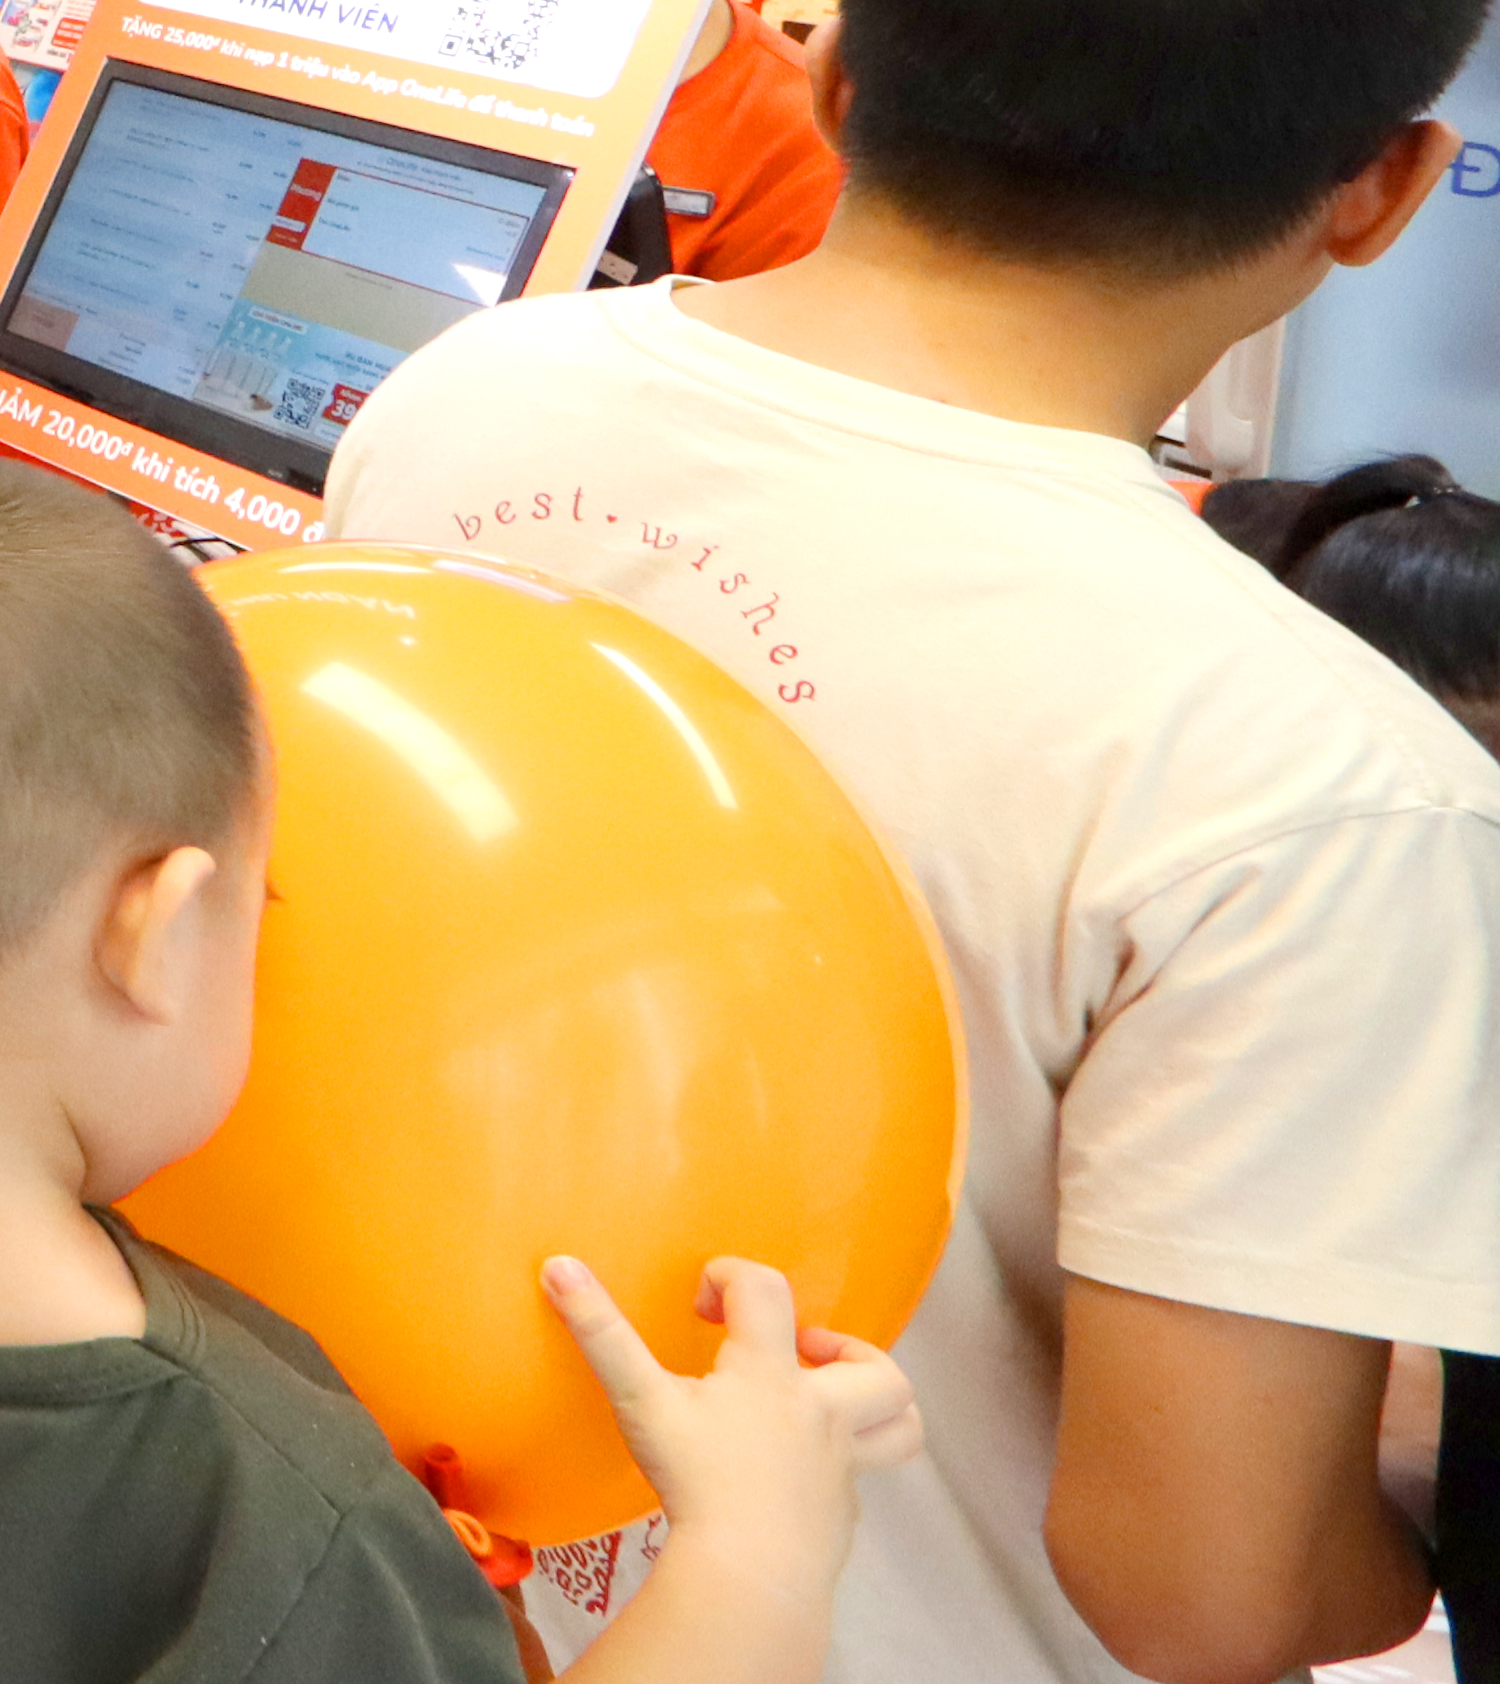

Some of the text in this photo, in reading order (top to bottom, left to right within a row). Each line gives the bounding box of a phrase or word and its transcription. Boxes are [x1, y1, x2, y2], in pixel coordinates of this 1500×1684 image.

[122, 15, 165, 41] TẶNG
[338, 2, 399, 34] VIÊN
[132, 447, 174, 484] khi
[173, 463, 221, 504] tích
[223, 487, 301, 536] 4,000
[454, 486, 817, 704] best wishes
